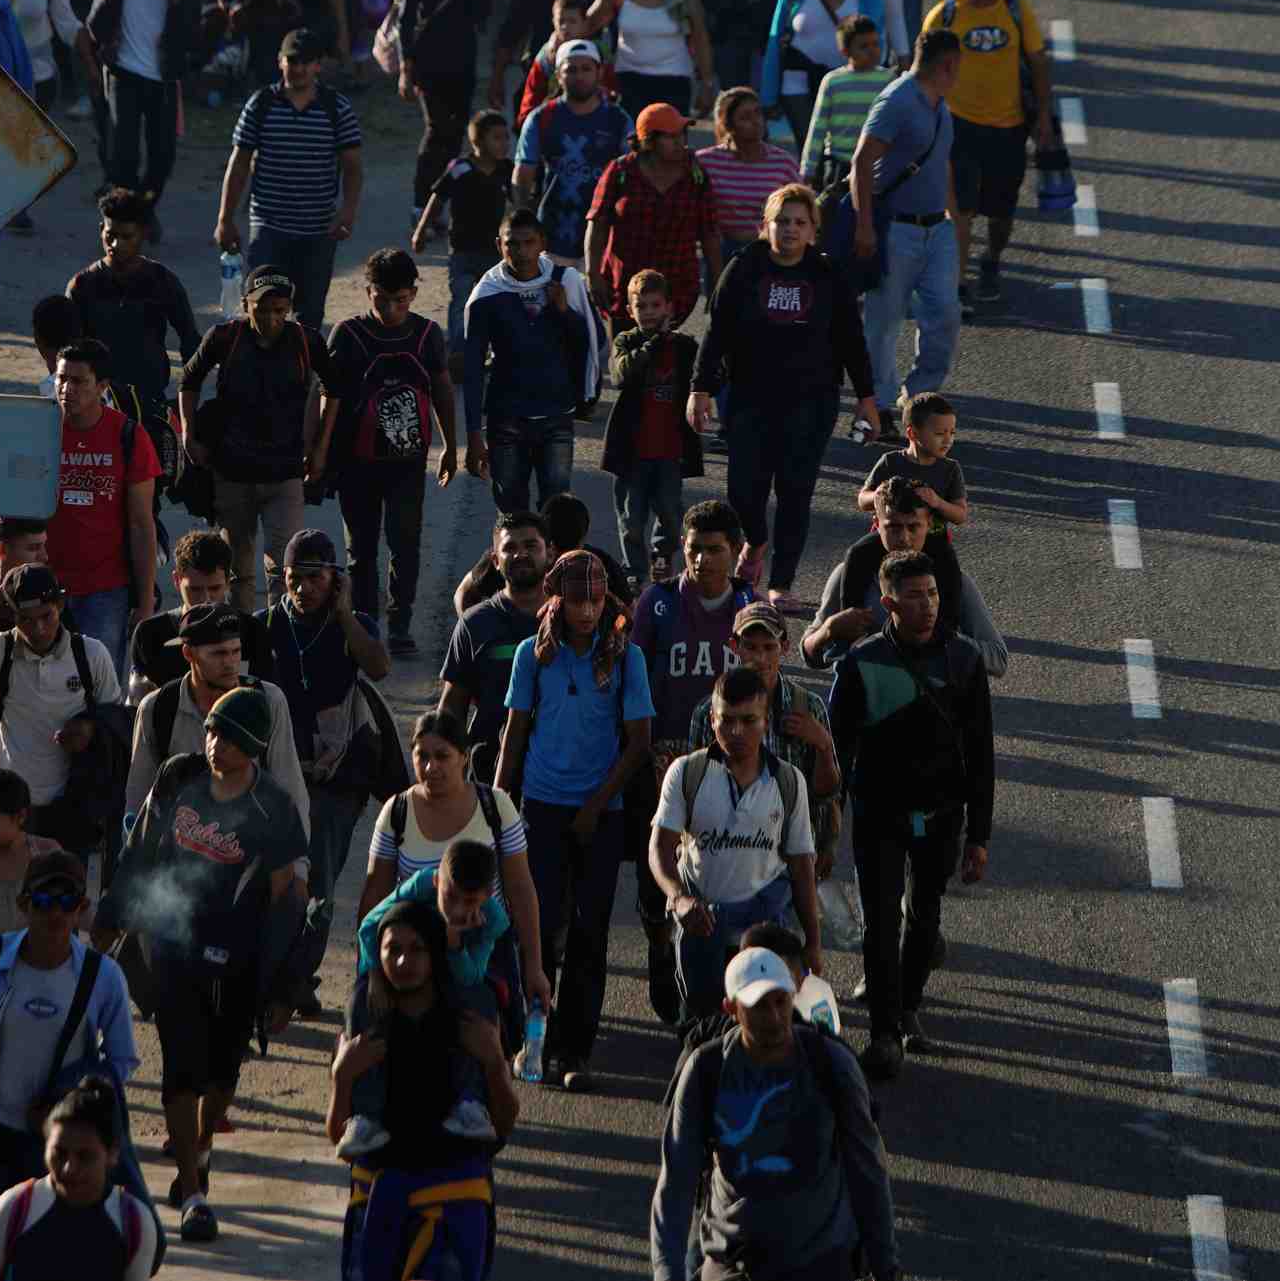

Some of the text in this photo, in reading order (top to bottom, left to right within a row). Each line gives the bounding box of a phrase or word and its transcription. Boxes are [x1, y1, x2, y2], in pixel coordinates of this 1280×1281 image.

[768, 299, 801, 311] RUN
[60, 452, 113, 467] LWAYS
[669, 640, 741, 678] GAP
